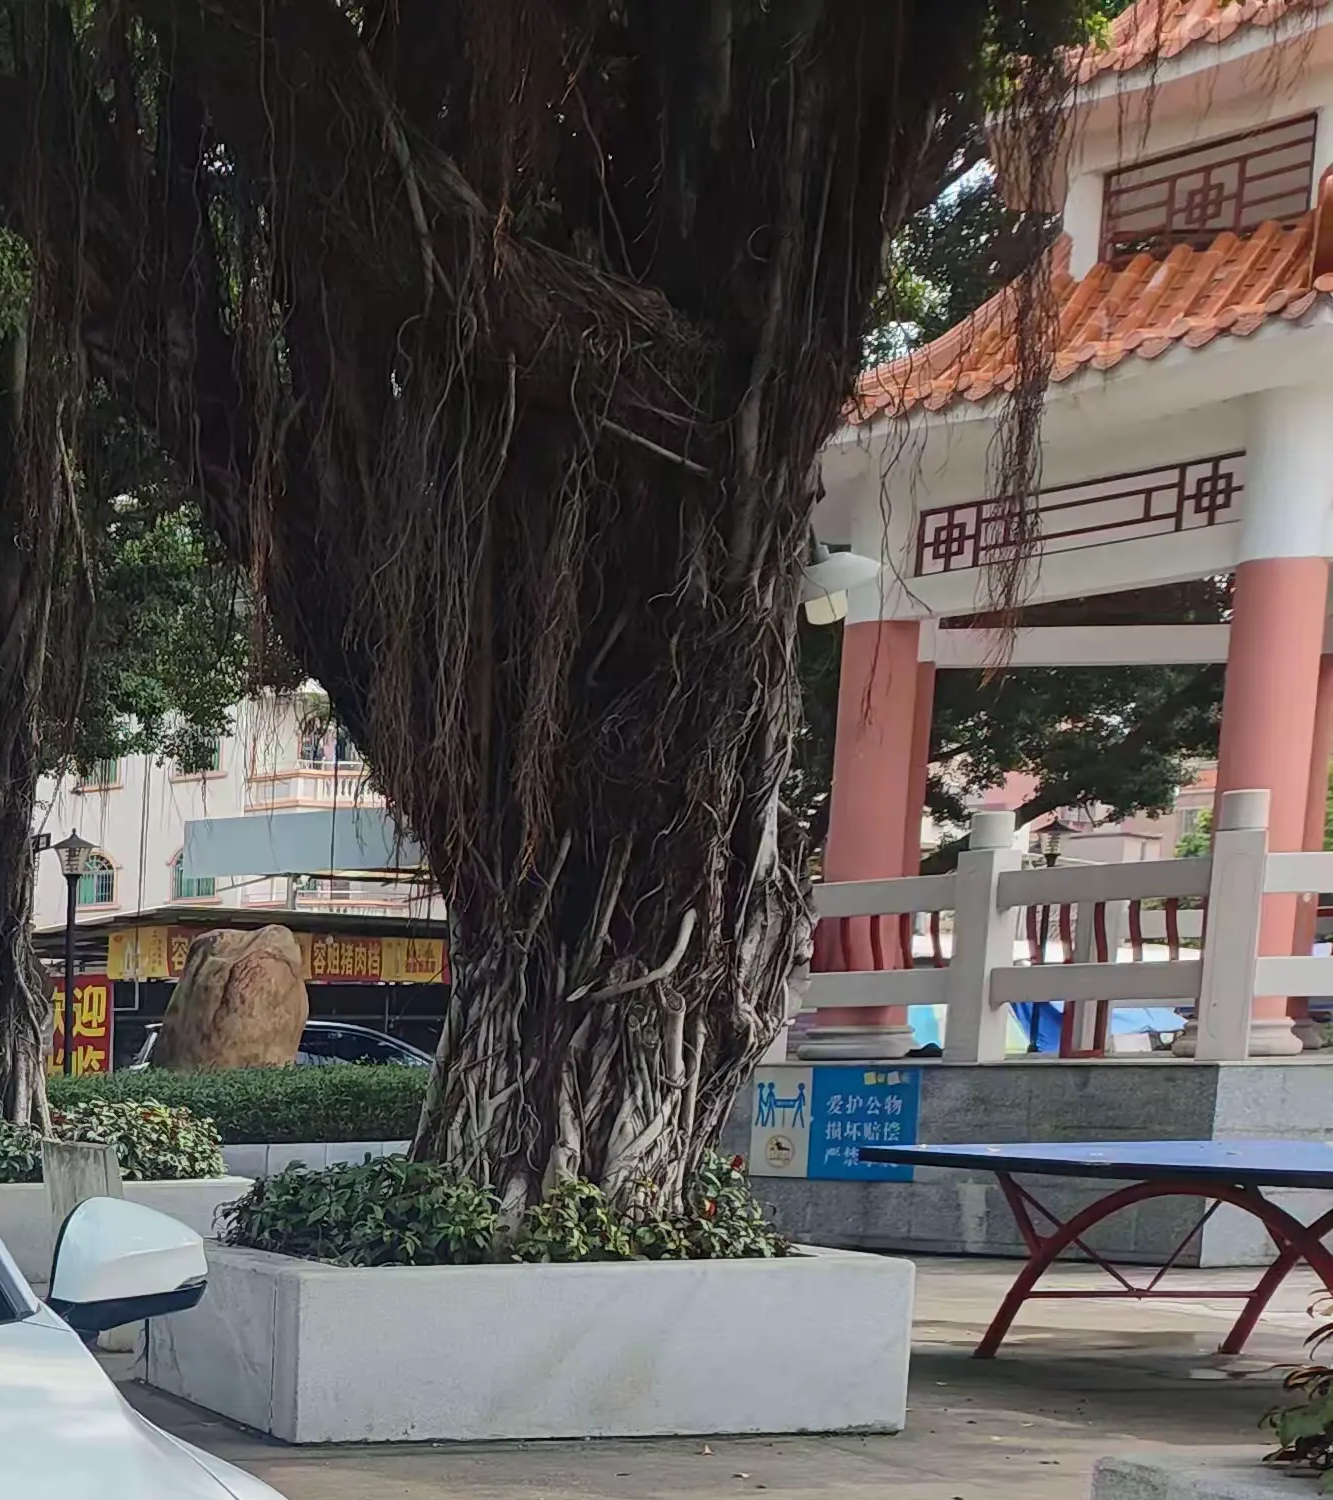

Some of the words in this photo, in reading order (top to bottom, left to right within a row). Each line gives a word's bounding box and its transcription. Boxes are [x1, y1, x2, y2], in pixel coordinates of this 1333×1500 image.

[826, 1094, 903, 1115] 爱护公物
[825, 1121, 901, 1141] 损坏赔偿
